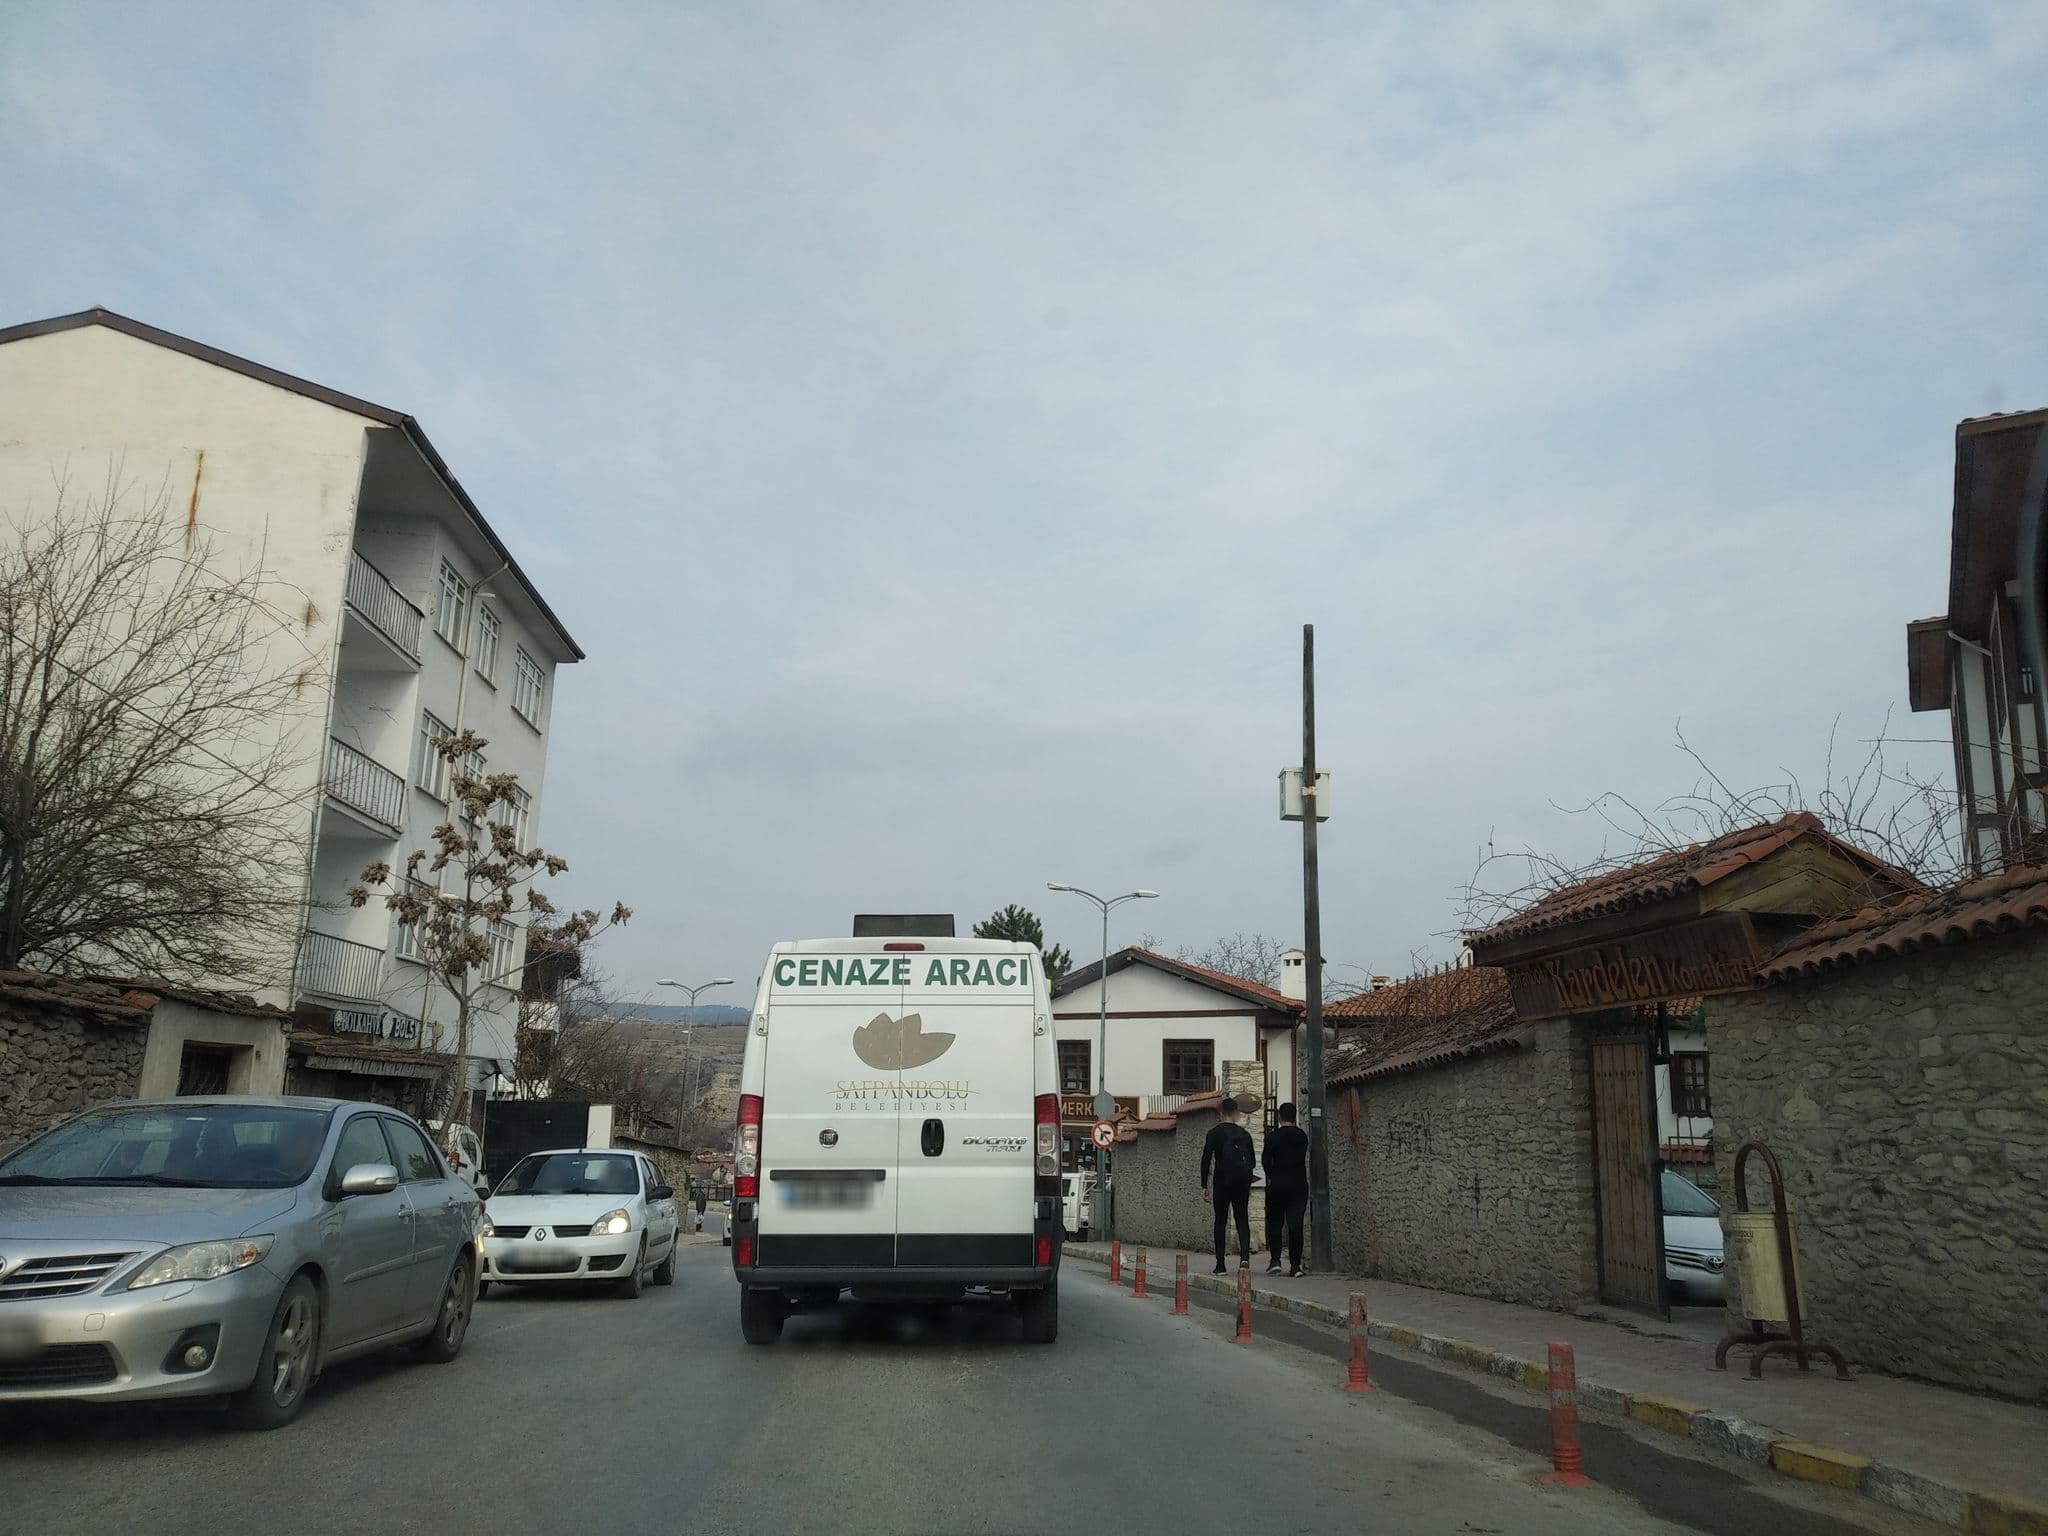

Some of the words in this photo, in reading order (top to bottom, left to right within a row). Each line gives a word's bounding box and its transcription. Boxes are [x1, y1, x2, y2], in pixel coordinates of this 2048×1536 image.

[774, 959, 912, 987] CENAZE
[925, 959, 1029, 986] ARACI
[963, 1137, 1028, 1145] DUCATO
